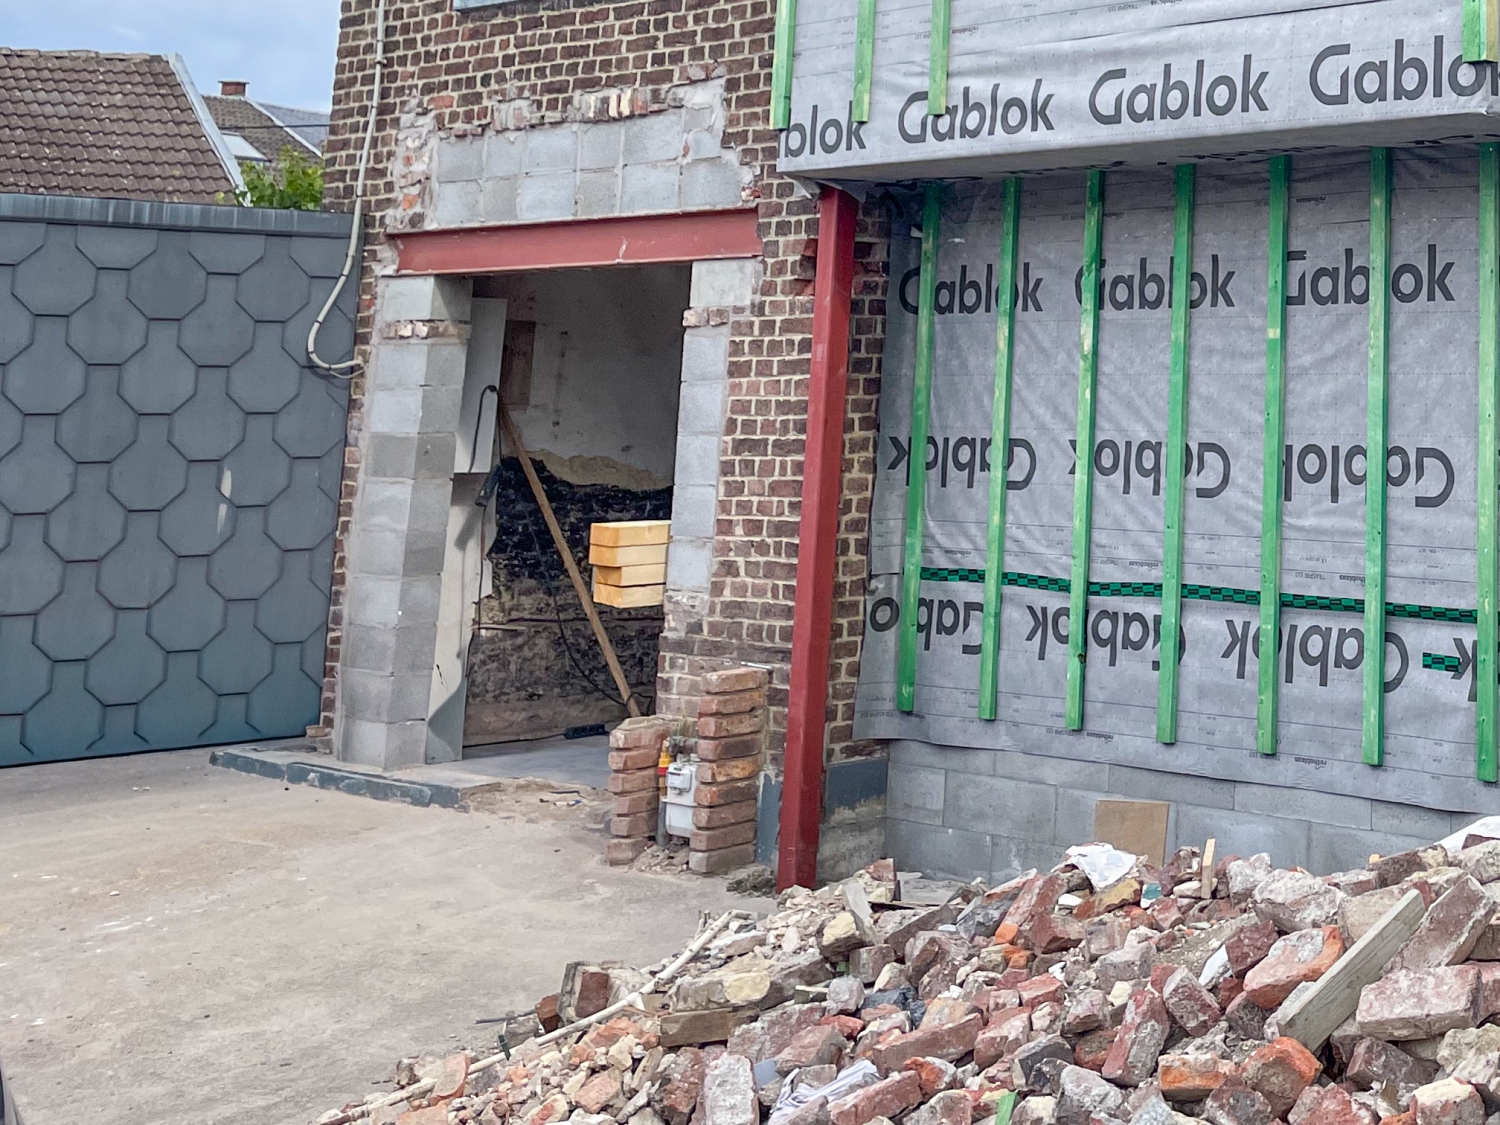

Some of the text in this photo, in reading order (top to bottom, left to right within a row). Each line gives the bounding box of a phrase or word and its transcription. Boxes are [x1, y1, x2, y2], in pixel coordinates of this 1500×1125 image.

[1088, 54, 1269, 125] Gablok
[1286, 244, 1457, 307] Gabok
[1025, 605, 1187, 671] abok
